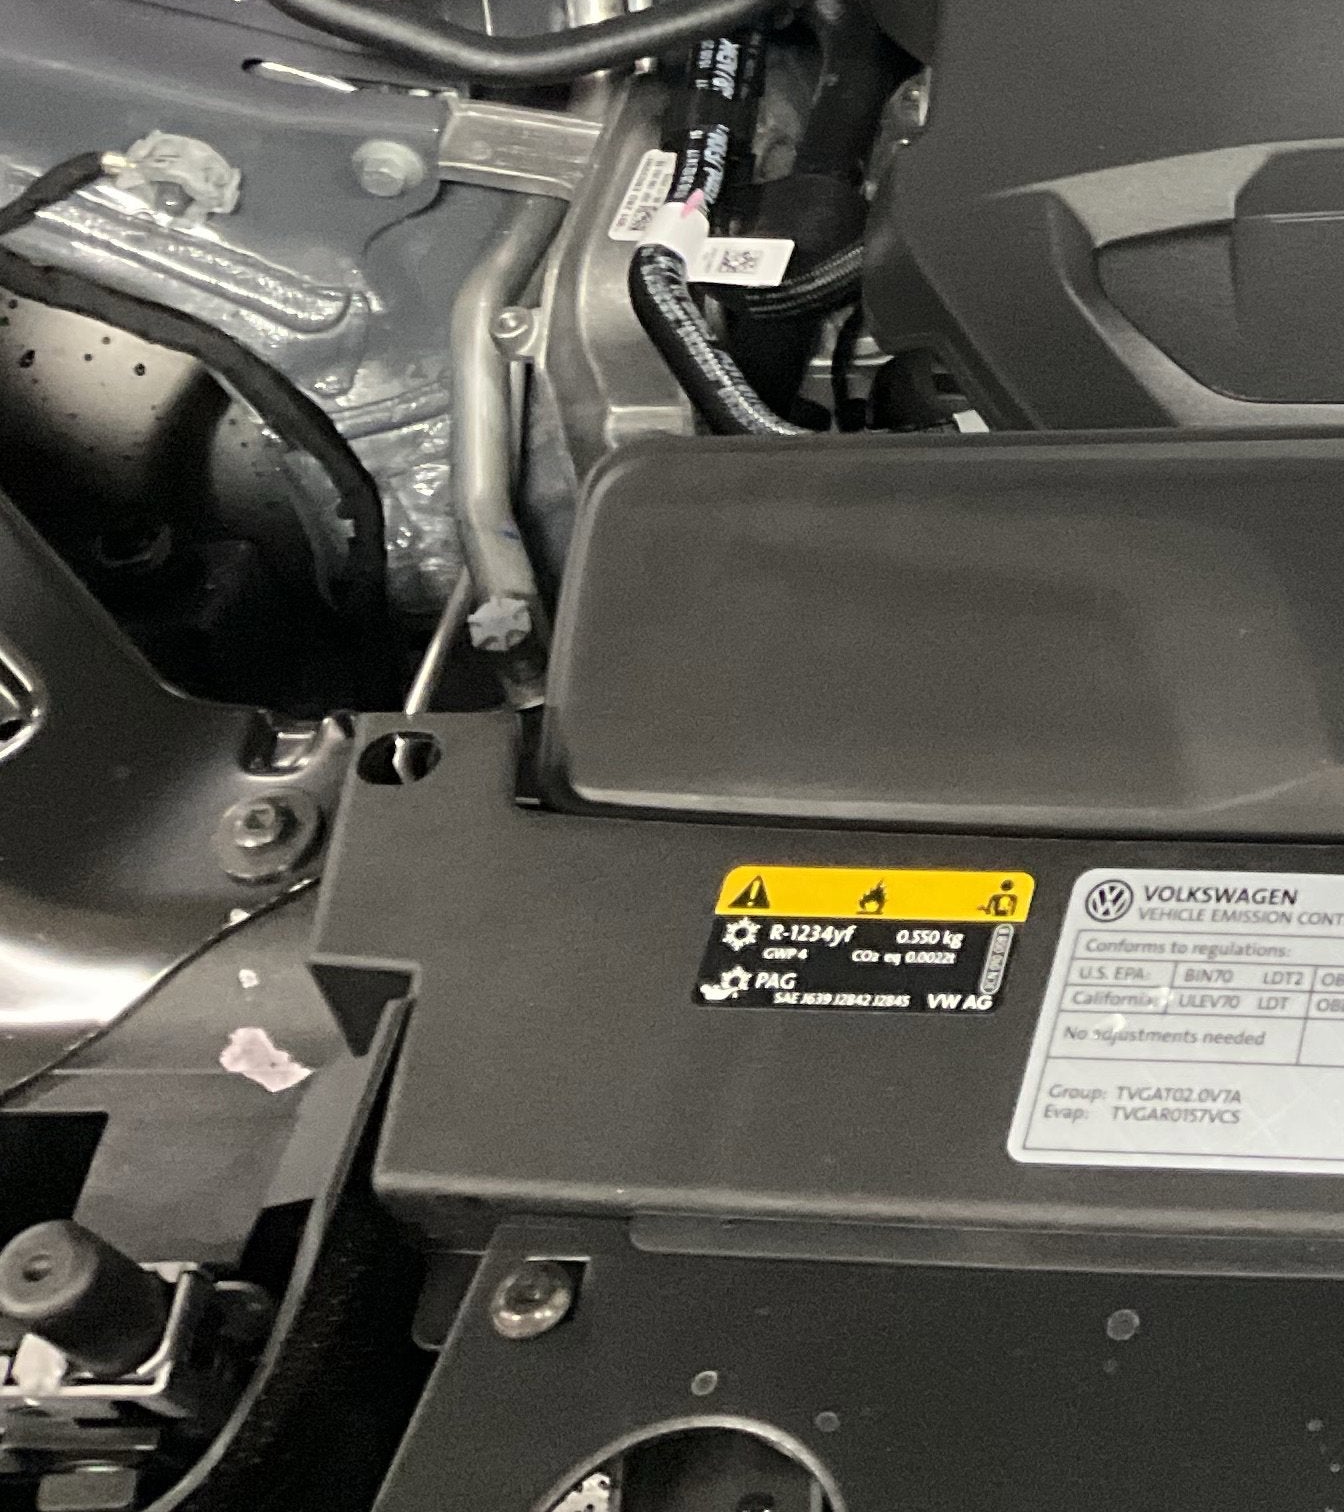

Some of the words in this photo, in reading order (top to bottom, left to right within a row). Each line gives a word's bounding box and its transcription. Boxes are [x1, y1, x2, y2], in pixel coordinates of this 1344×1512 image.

[1143, 885, 1298, 905] VOLKSWAGEN
[1138, 907, 1208, 922] VEHICLE
[1211, 908, 1293, 924] EMISSION
[769, 924, 856, 946] R-1234yf
[896, 930, 941, 945] 0.550
[942, 930, 965, 948] kg
[762, 948, 795, 960] GWP
[1085, 938, 1166, 954] Conforms
[1170, 941, 1187, 955] to
[1191, 941, 1291, 960] regulations:
[884, 953, 901, 966] eq
[754, 972, 797, 990] PAG
[1078, 966, 1109, 981] U.S.
[1182, 968, 1235, 984] BIN70
[1262, 971, 1304, 986] LDT2
[773, 992, 800, 1005] SAE
[926, 994, 961, 1009] VW
[961, 995, 993, 1011] AG
[1178, 994, 1241, 1009] ULEV70
[1257, 996, 1289, 1010] LDT
[1063, 1026, 1088, 1041] No
[1093, 1028, 1199, 1047] adjustments
[1201, 1031, 1267, 1046] needed
[1049, 1083, 1107, 1103] Group:
[1043, 1104, 1090, 1123] Evap:
